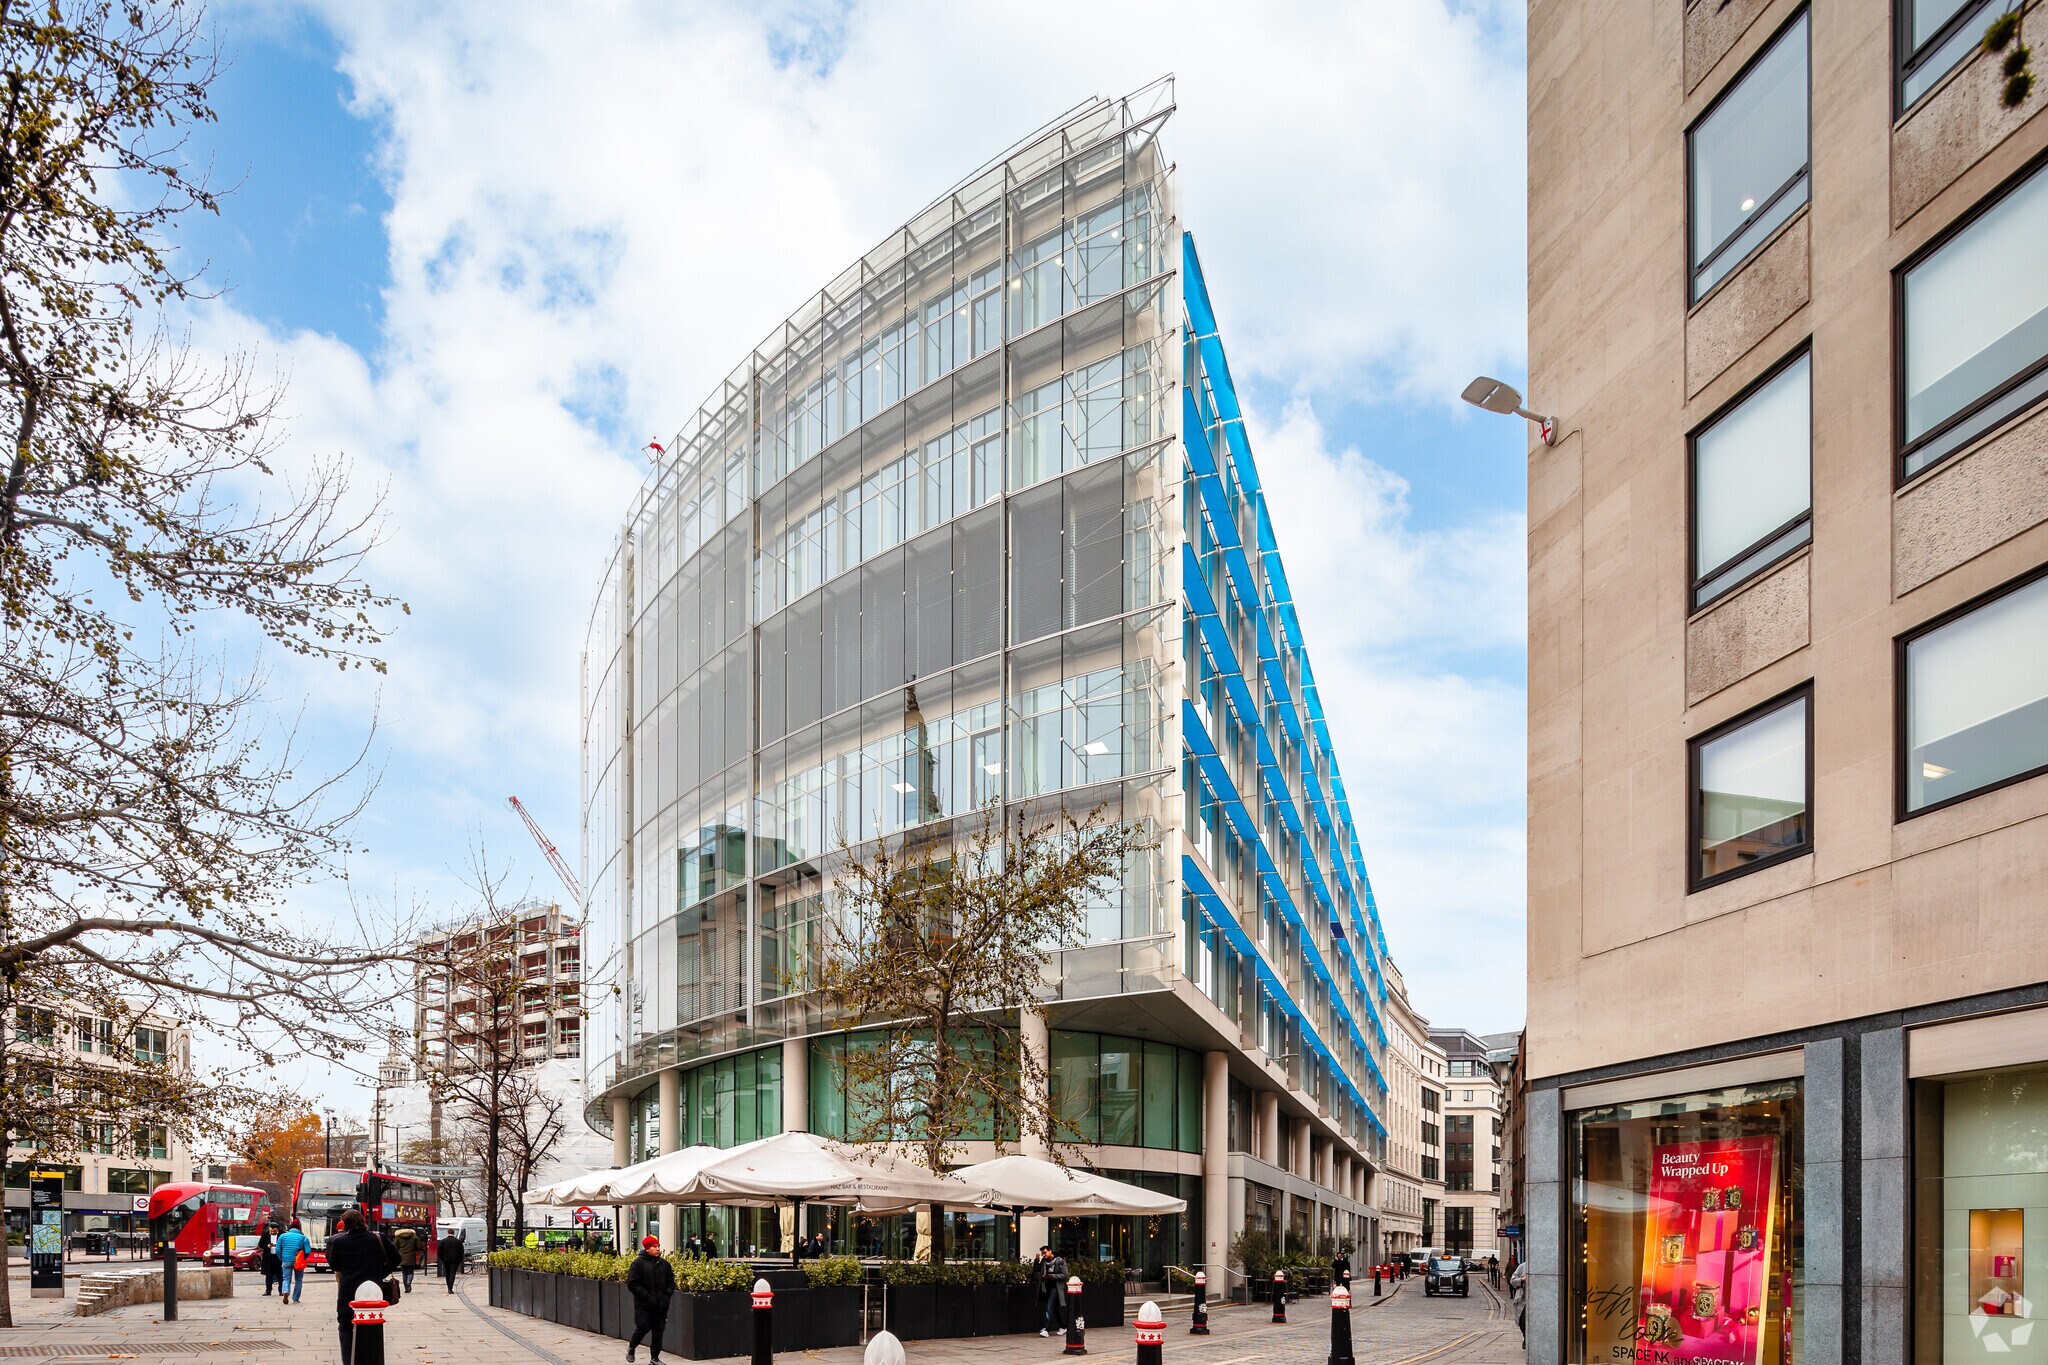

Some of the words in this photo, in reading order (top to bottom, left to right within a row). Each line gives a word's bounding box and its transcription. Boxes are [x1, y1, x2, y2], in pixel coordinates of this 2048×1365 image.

[1661, 1153, 1700, 1165] Beauty
[1661, 1163, 1710, 1179] Wrapped
[1712, 1162, 1729, 1177] Up
